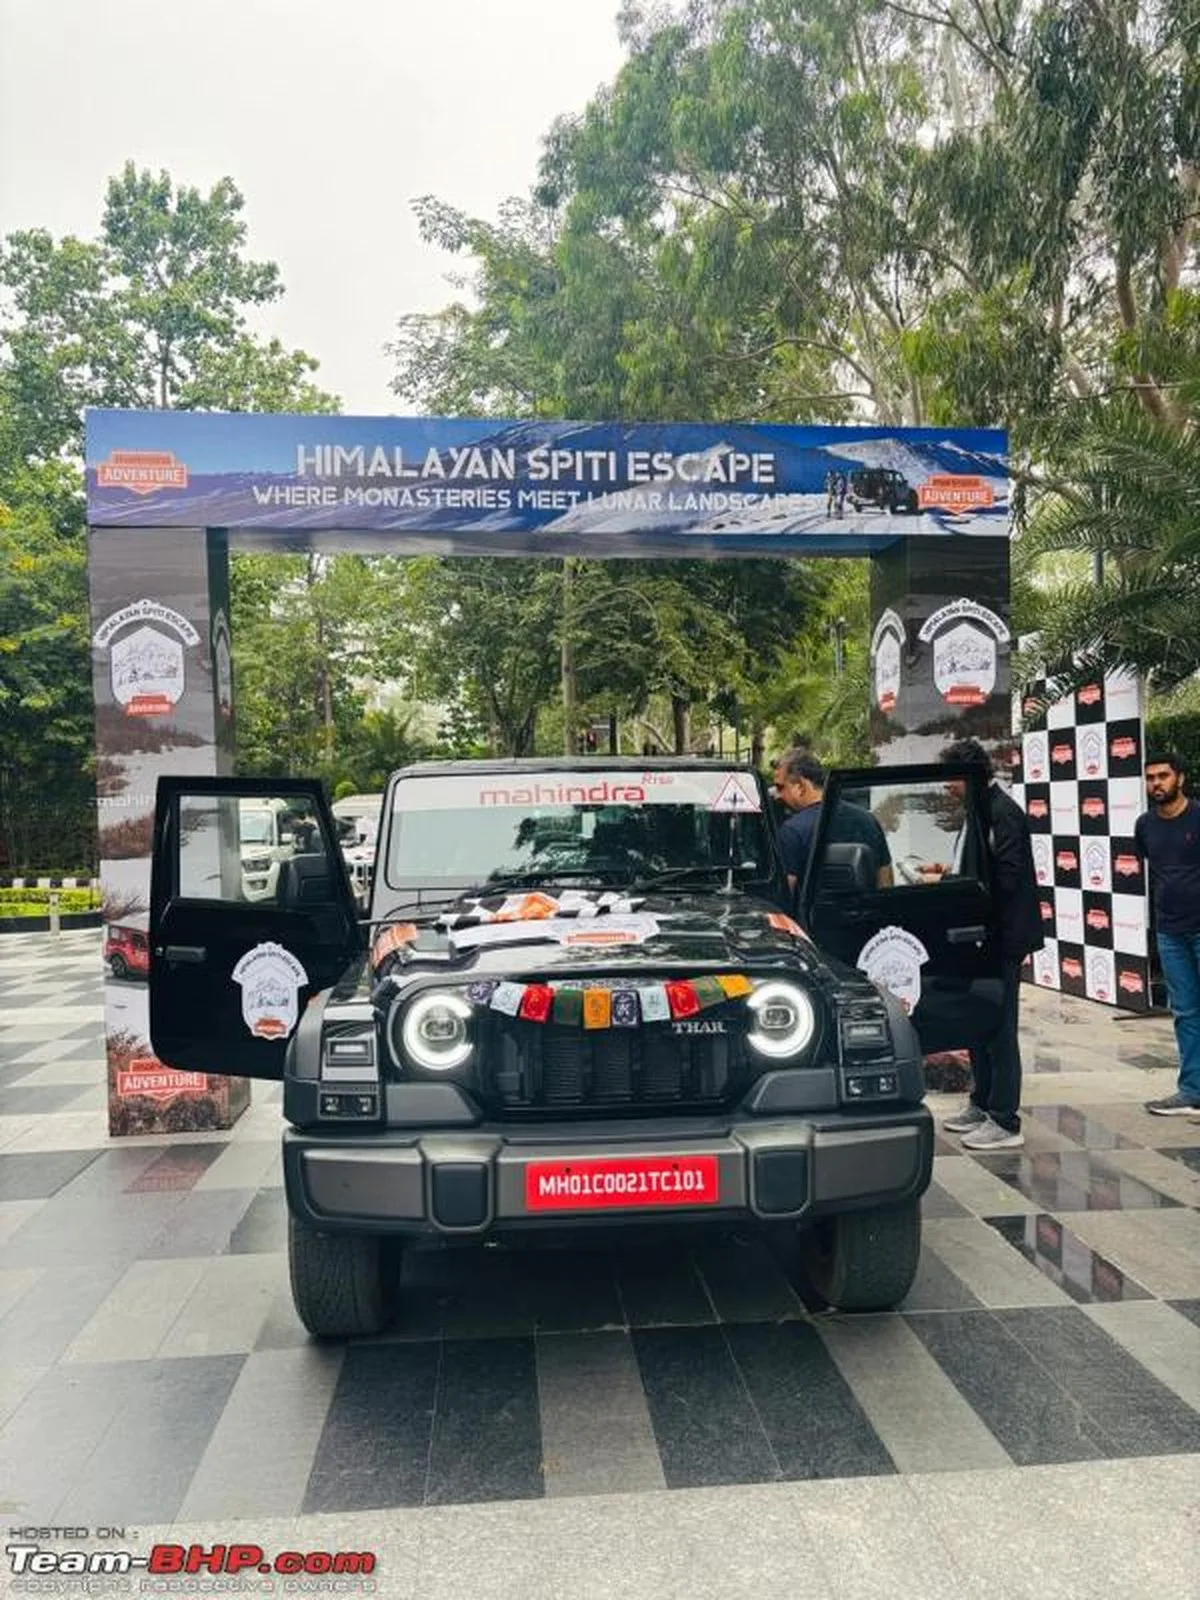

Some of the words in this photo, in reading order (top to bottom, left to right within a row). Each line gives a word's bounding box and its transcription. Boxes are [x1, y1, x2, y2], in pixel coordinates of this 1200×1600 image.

[297, 444, 516, 480] HIMALAYAN
[527, 449, 617, 482] SPITI
[627, 451, 775, 484] ESCAPE
[103, 467, 185, 483] ADVENTURE
[252, 485, 338, 506] WHERE
[344, 487, 512, 509] MONASTERIES
[518, 489, 581, 510] MEET
[588, 491, 662, 511] LUNAR
[480, 781, 645, 805] mahindra
[671, 1020, 728, 1035] THAR
[124, 1073, 201, 1090] ADVENTURE
